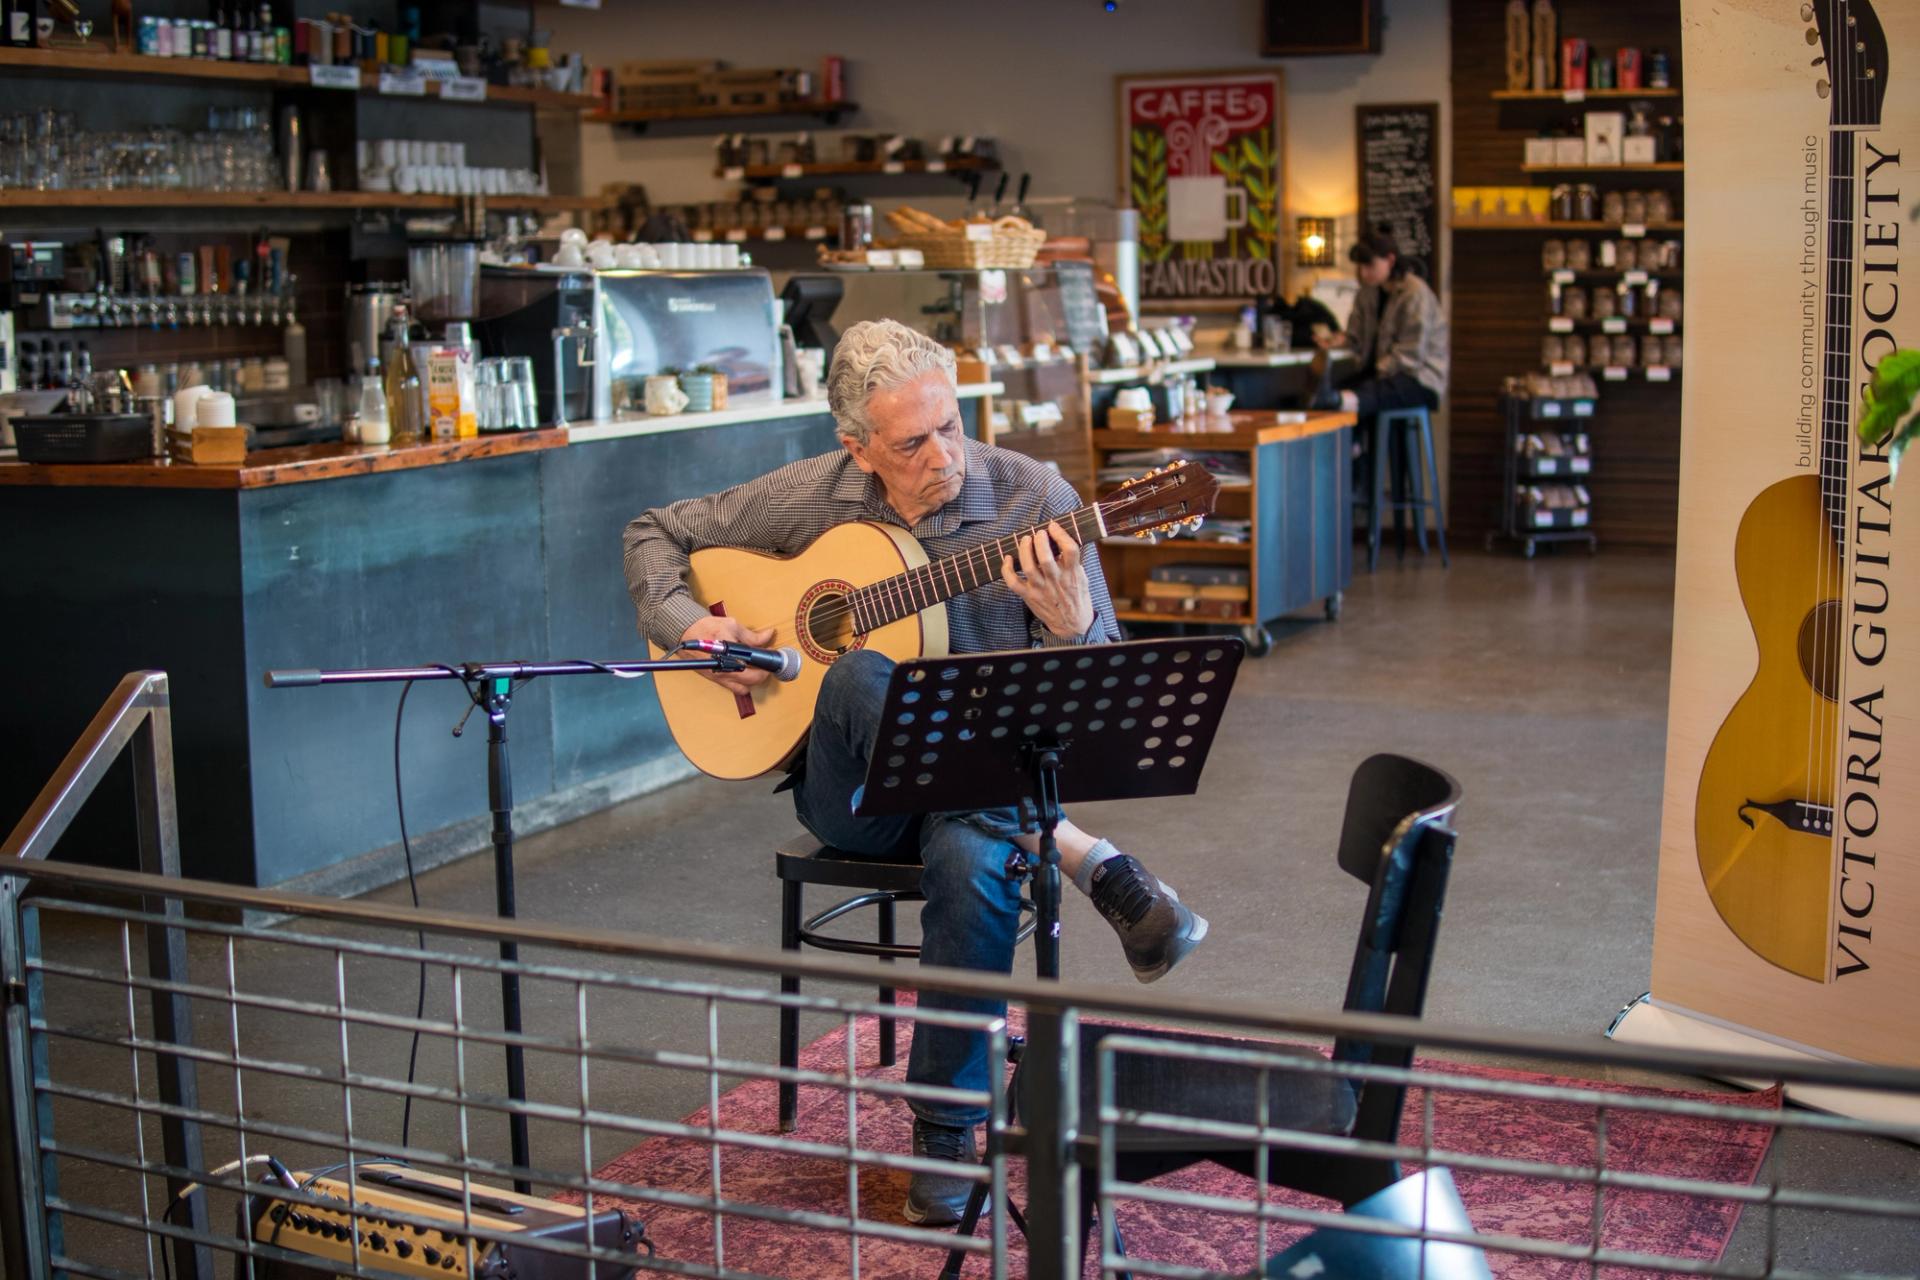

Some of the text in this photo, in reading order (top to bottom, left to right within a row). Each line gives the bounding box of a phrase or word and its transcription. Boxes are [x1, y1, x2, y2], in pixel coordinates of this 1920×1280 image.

[1140, 259, 1275, 295] FANTASTICO
[1795, 135, 1820, 468] building community through music
[1835, 685, 1885, 978] VICTORIA
